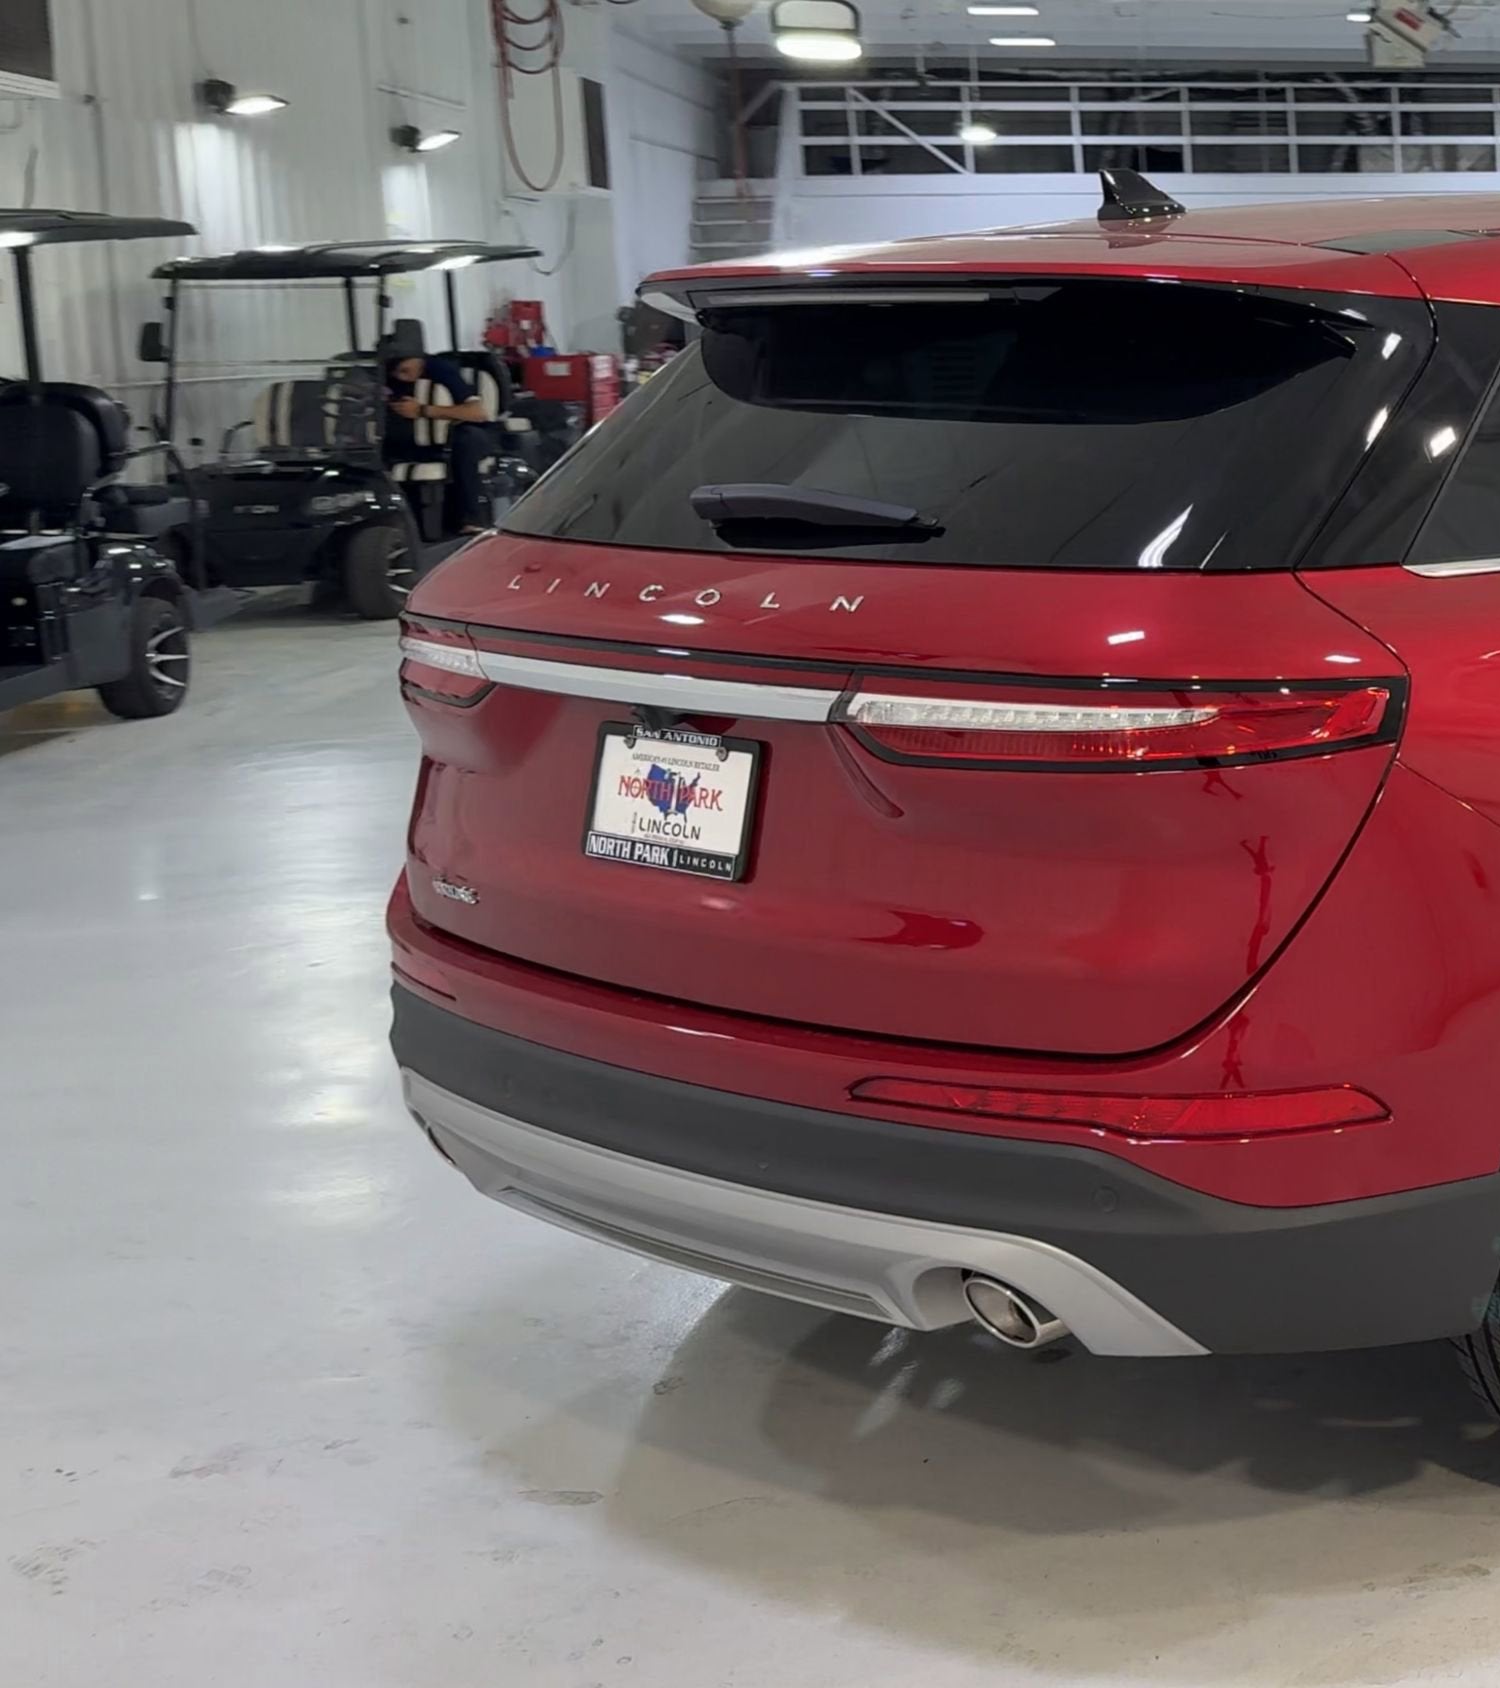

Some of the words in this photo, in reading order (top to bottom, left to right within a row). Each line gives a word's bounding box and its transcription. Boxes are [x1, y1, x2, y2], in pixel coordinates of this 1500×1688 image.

[508, 574, 864, 613] LINCOLN
[636, 728, 661, 740] SAN
[664, 731, 718, 747] ANTONIO
[617, 775, 673, 800] NORTH
[679, 784, 723, 811] PARK
[639, 817, 701, 841] LINCOLN
[589, 835, 632, 859] NORTH
[634, 843, 670, 866] PARK
[680, 854, 731, 871] LINCOLN
